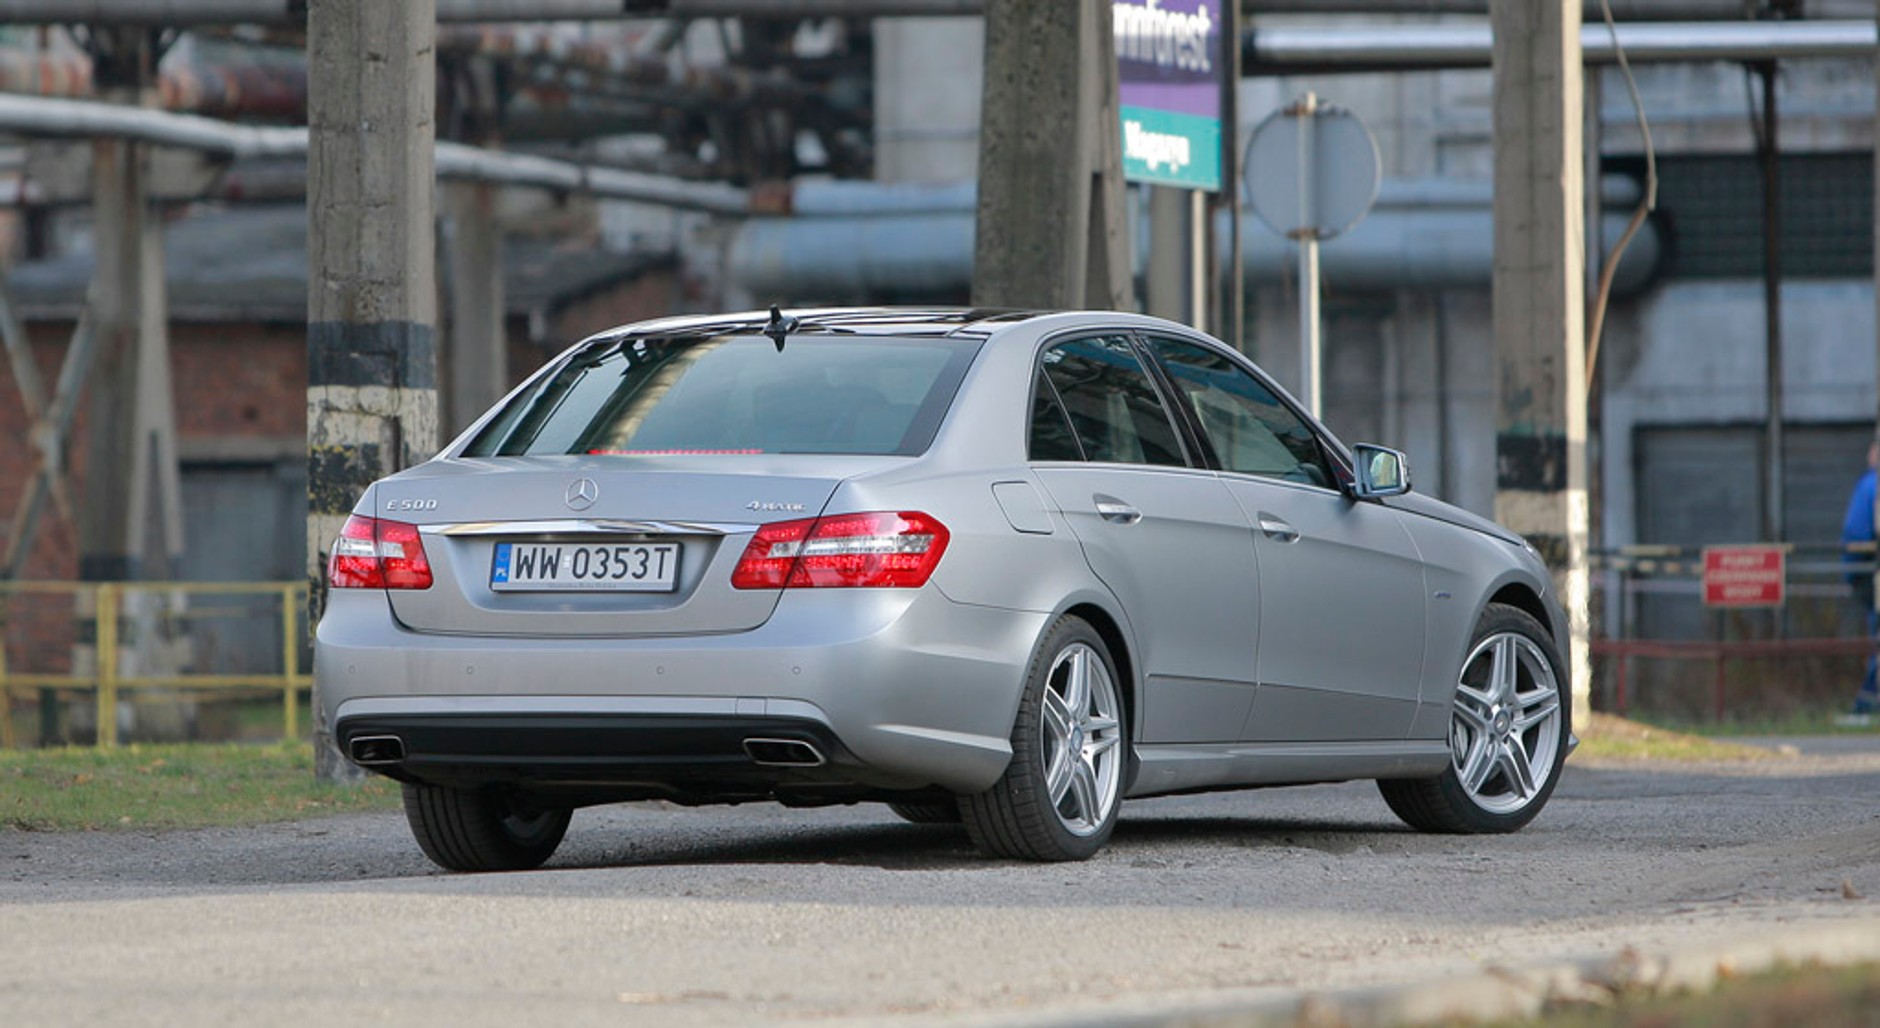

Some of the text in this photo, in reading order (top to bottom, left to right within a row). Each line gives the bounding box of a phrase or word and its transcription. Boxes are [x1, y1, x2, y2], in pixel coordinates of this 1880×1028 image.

[386, 499, 438, 511] E 500
[514, 546, 673, 580] WW 0353T
